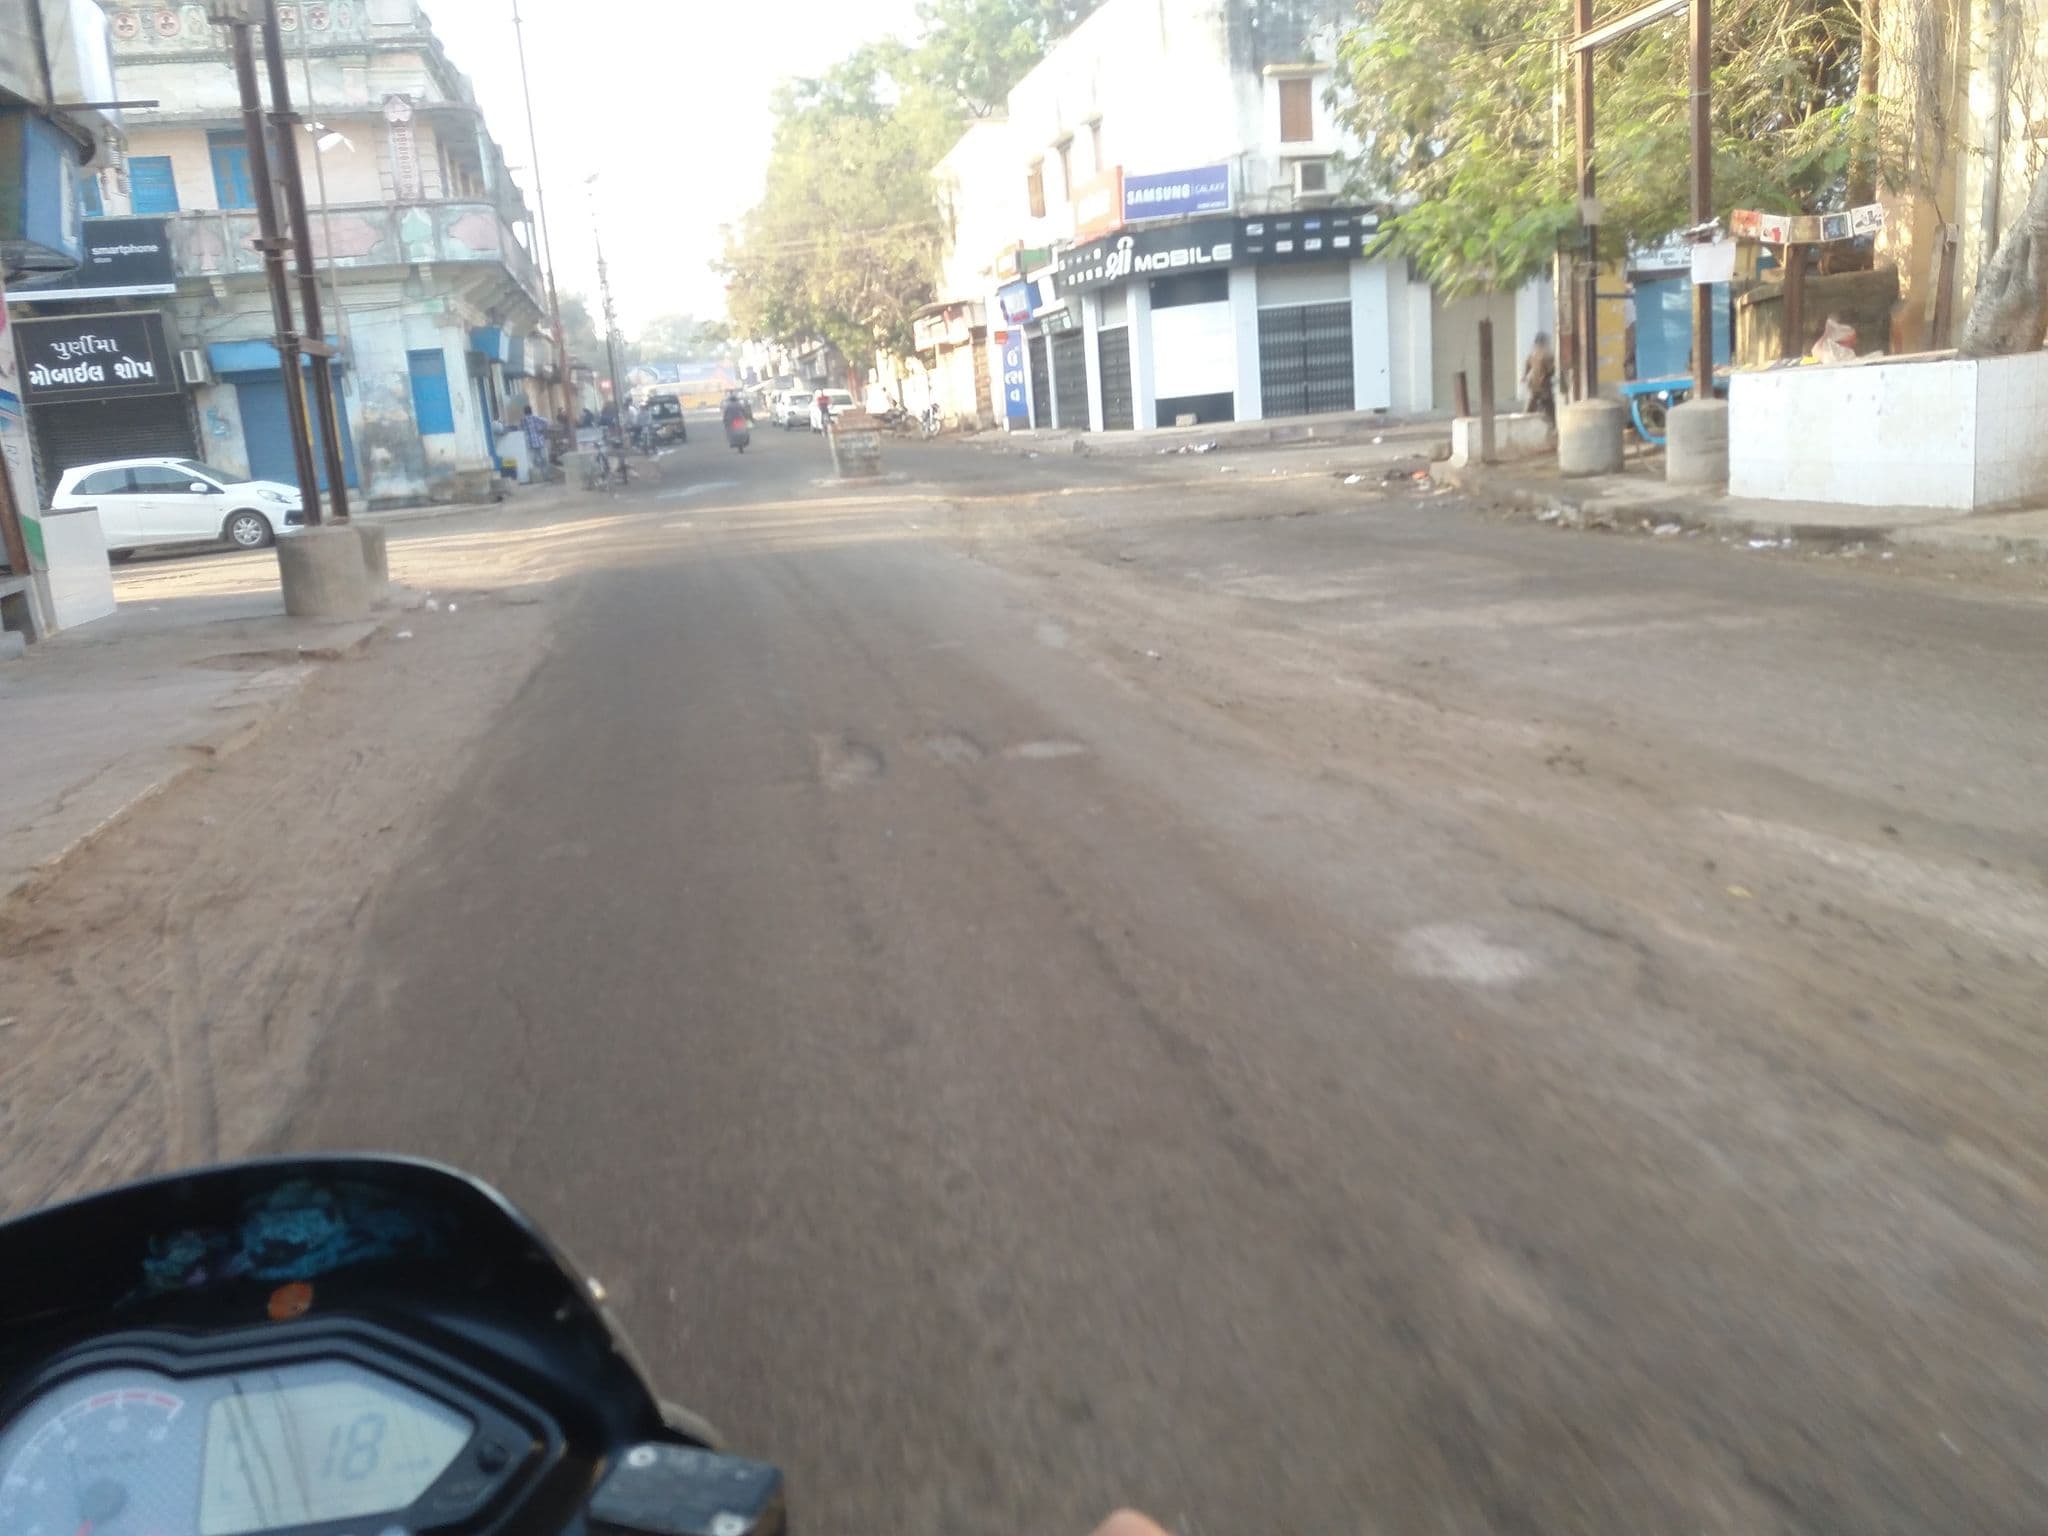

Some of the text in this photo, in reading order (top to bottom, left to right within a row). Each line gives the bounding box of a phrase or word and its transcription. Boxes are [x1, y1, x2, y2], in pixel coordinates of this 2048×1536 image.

[1127, 183, 1190, 206] SAMSUNG
[91, 244, 159, 256] smartphone
[1134, 243, 1233, 272] MOBILE
[114, 356, 155, 380] શોપ
[321, 1412, 388, 1482] 18
